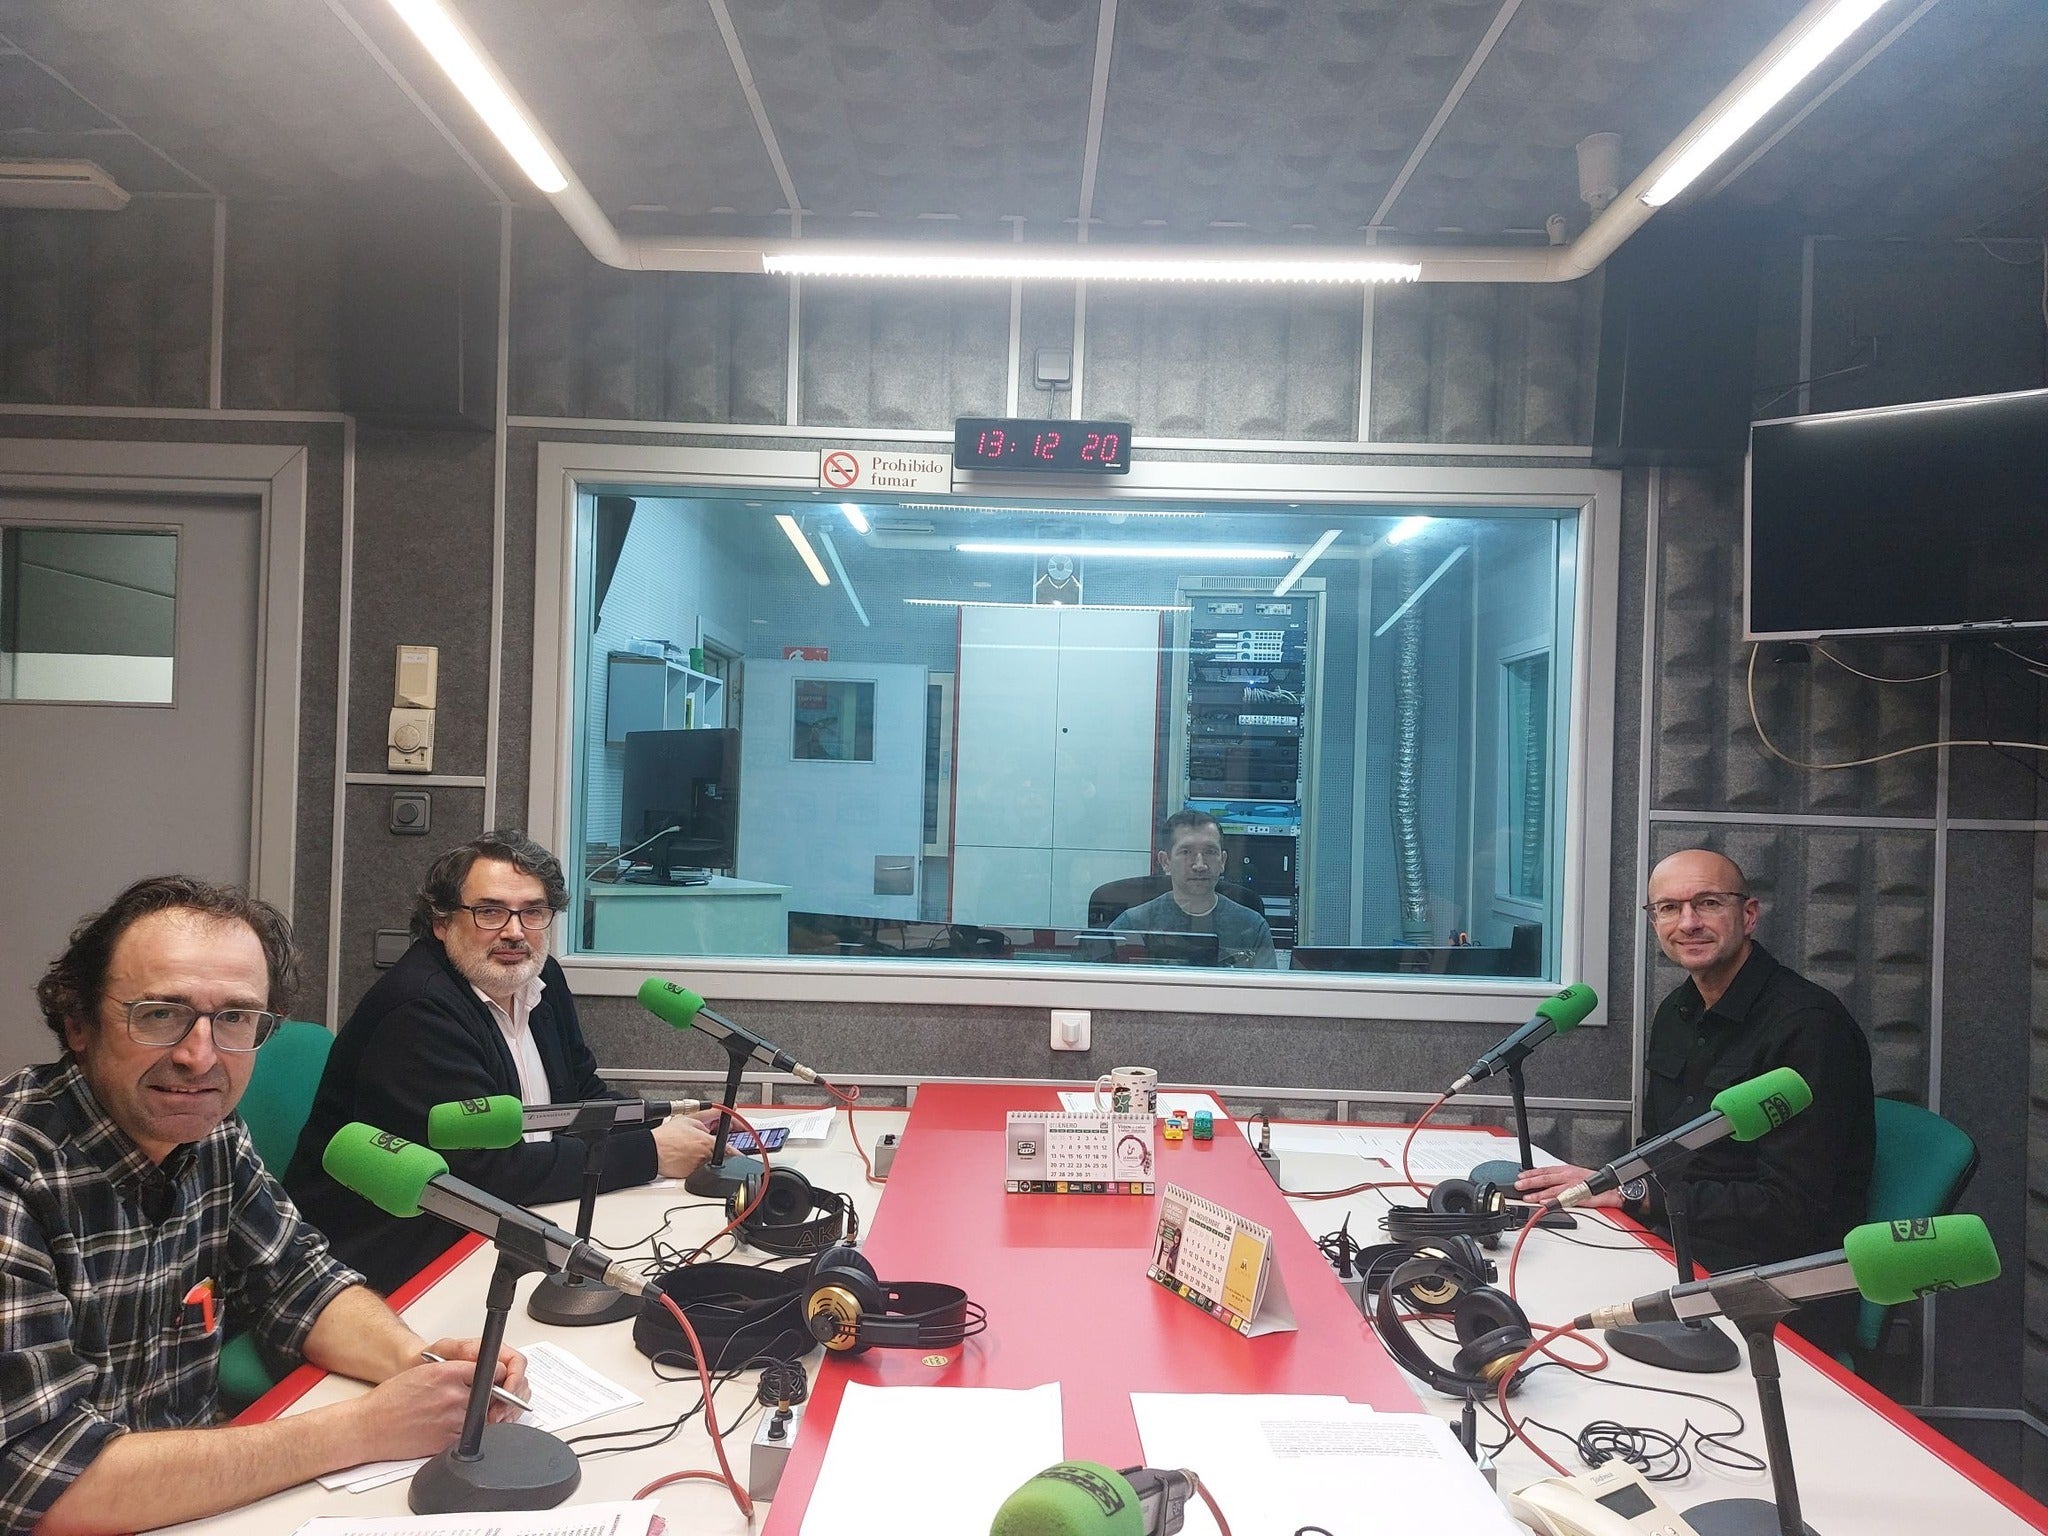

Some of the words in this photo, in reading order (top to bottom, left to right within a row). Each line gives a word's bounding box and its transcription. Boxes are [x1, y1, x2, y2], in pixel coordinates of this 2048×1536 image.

[1033, 431, 1060, 460] 12
[1081, 433, 1119, 461] 20
[871, 456, 944, 474] Prohibido
[870, 474, 918, 488] fumar
